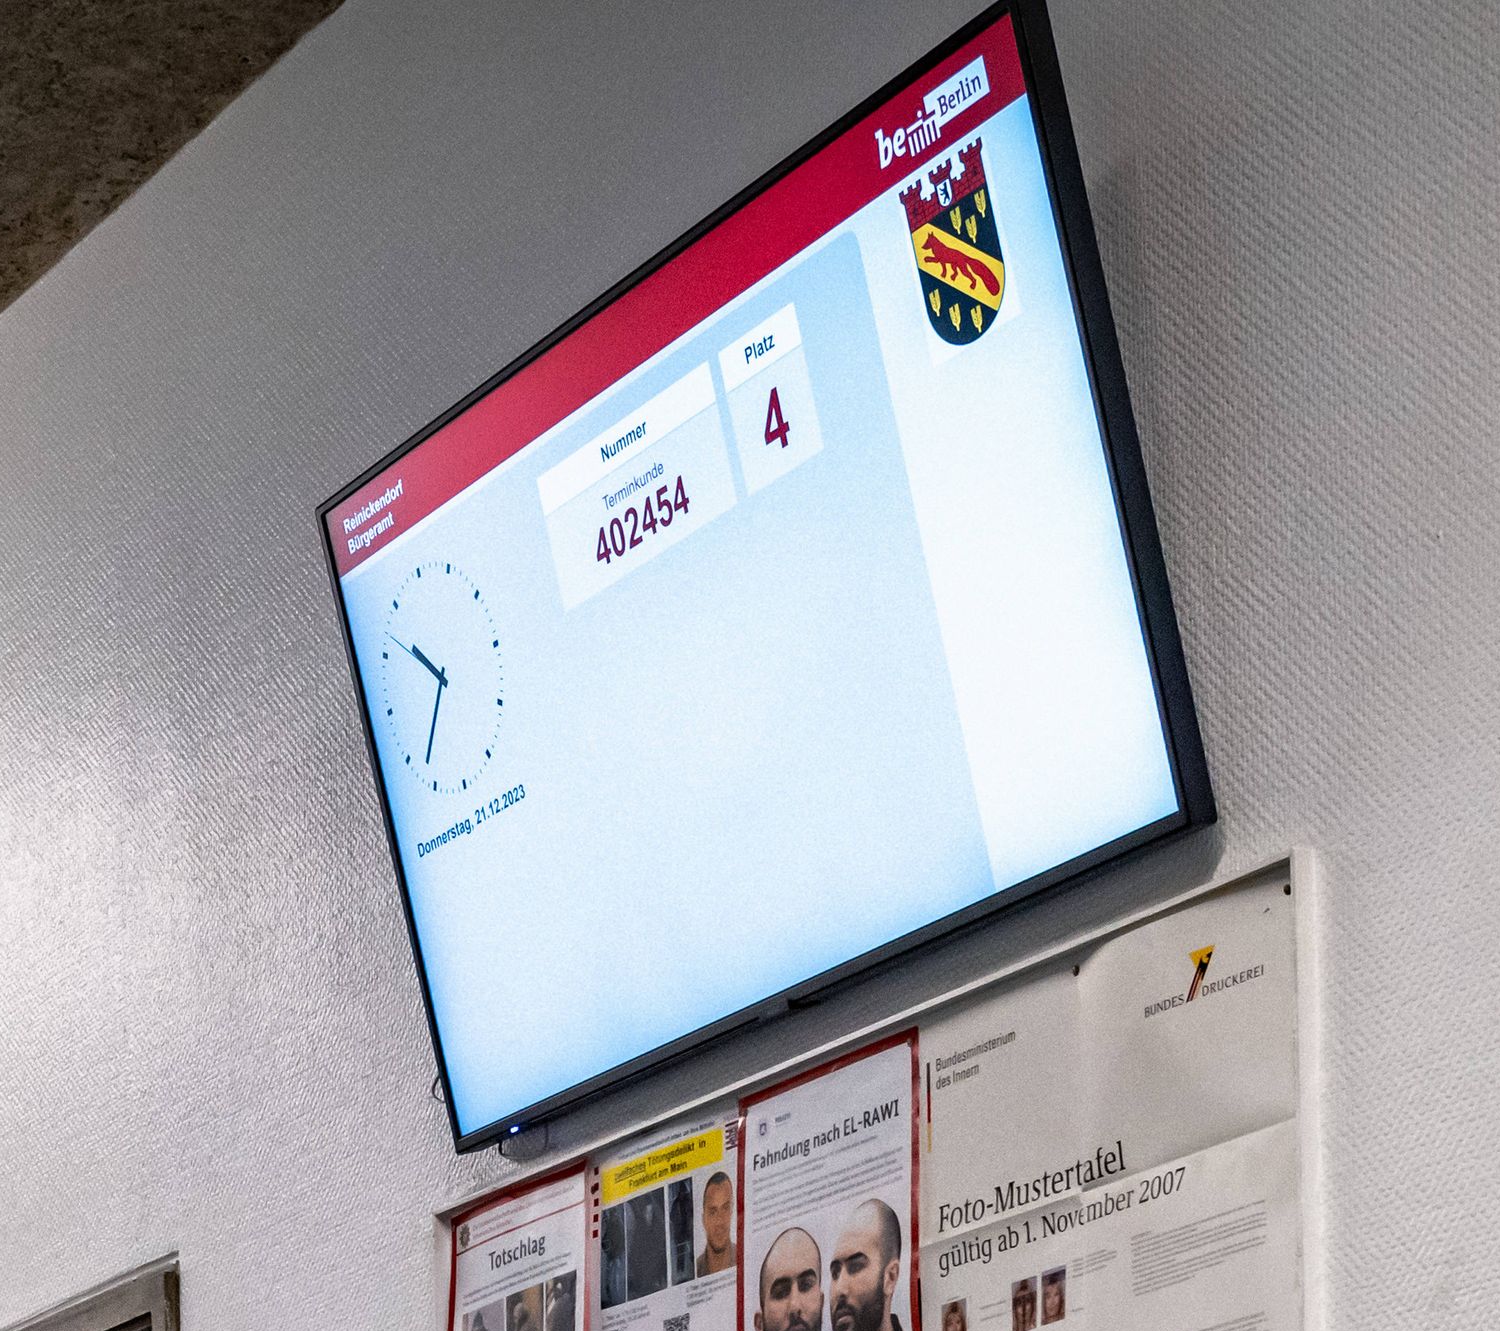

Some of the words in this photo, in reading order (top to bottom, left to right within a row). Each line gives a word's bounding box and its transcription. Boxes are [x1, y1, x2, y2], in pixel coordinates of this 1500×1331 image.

[937, 76, 981, 117] Berlin
[744, 335, 775, 364] Platz
[764, 387, 790, 448] 4
[600, 421, 647, 462] Nummer
[343, 479, 403, 534] Reinickendorf
[602, 462, 664, 510] Terminkunde
[347, 512, 394, 554] Bürgeramt
[597, 475, 689, 564] 402454
[418, 818, 474, 857] Donnerstag,
[475, 784, 526, 824] 21.12.2023
[1144, 994, 1185, 1019] BUNDES
[1201, 965, 1264, 997] DRUCKEREI
[936, 1030, 1016, 1072] Bundesministerium
[936, 1075, 951, 1090] des
[953, 1064, 980, 1085] Innern
[699, 1139, 706, 1148] in
[753, 1139, 810, 1171] Fahndung
[813, 1124, 840, 1148] nach
[844, 1099, 899, 1136] EL-RAWI
[658, 1168, 668, 1177] am
[670, 1161, 687, 1173] Main
[938, 1141, 1126, 1233] Foto-Mustertafel
[939, 1238, 992, 1277] gültig
[998, 1226, 1020, 1253] ab
[1025, 1221, 1037, 1244] 1.
[1041, 1188, 1134, 1237] November
[1138, 1167, 1186, 1205] 2007
[489, 1236, 545, 1270] Totschlag
